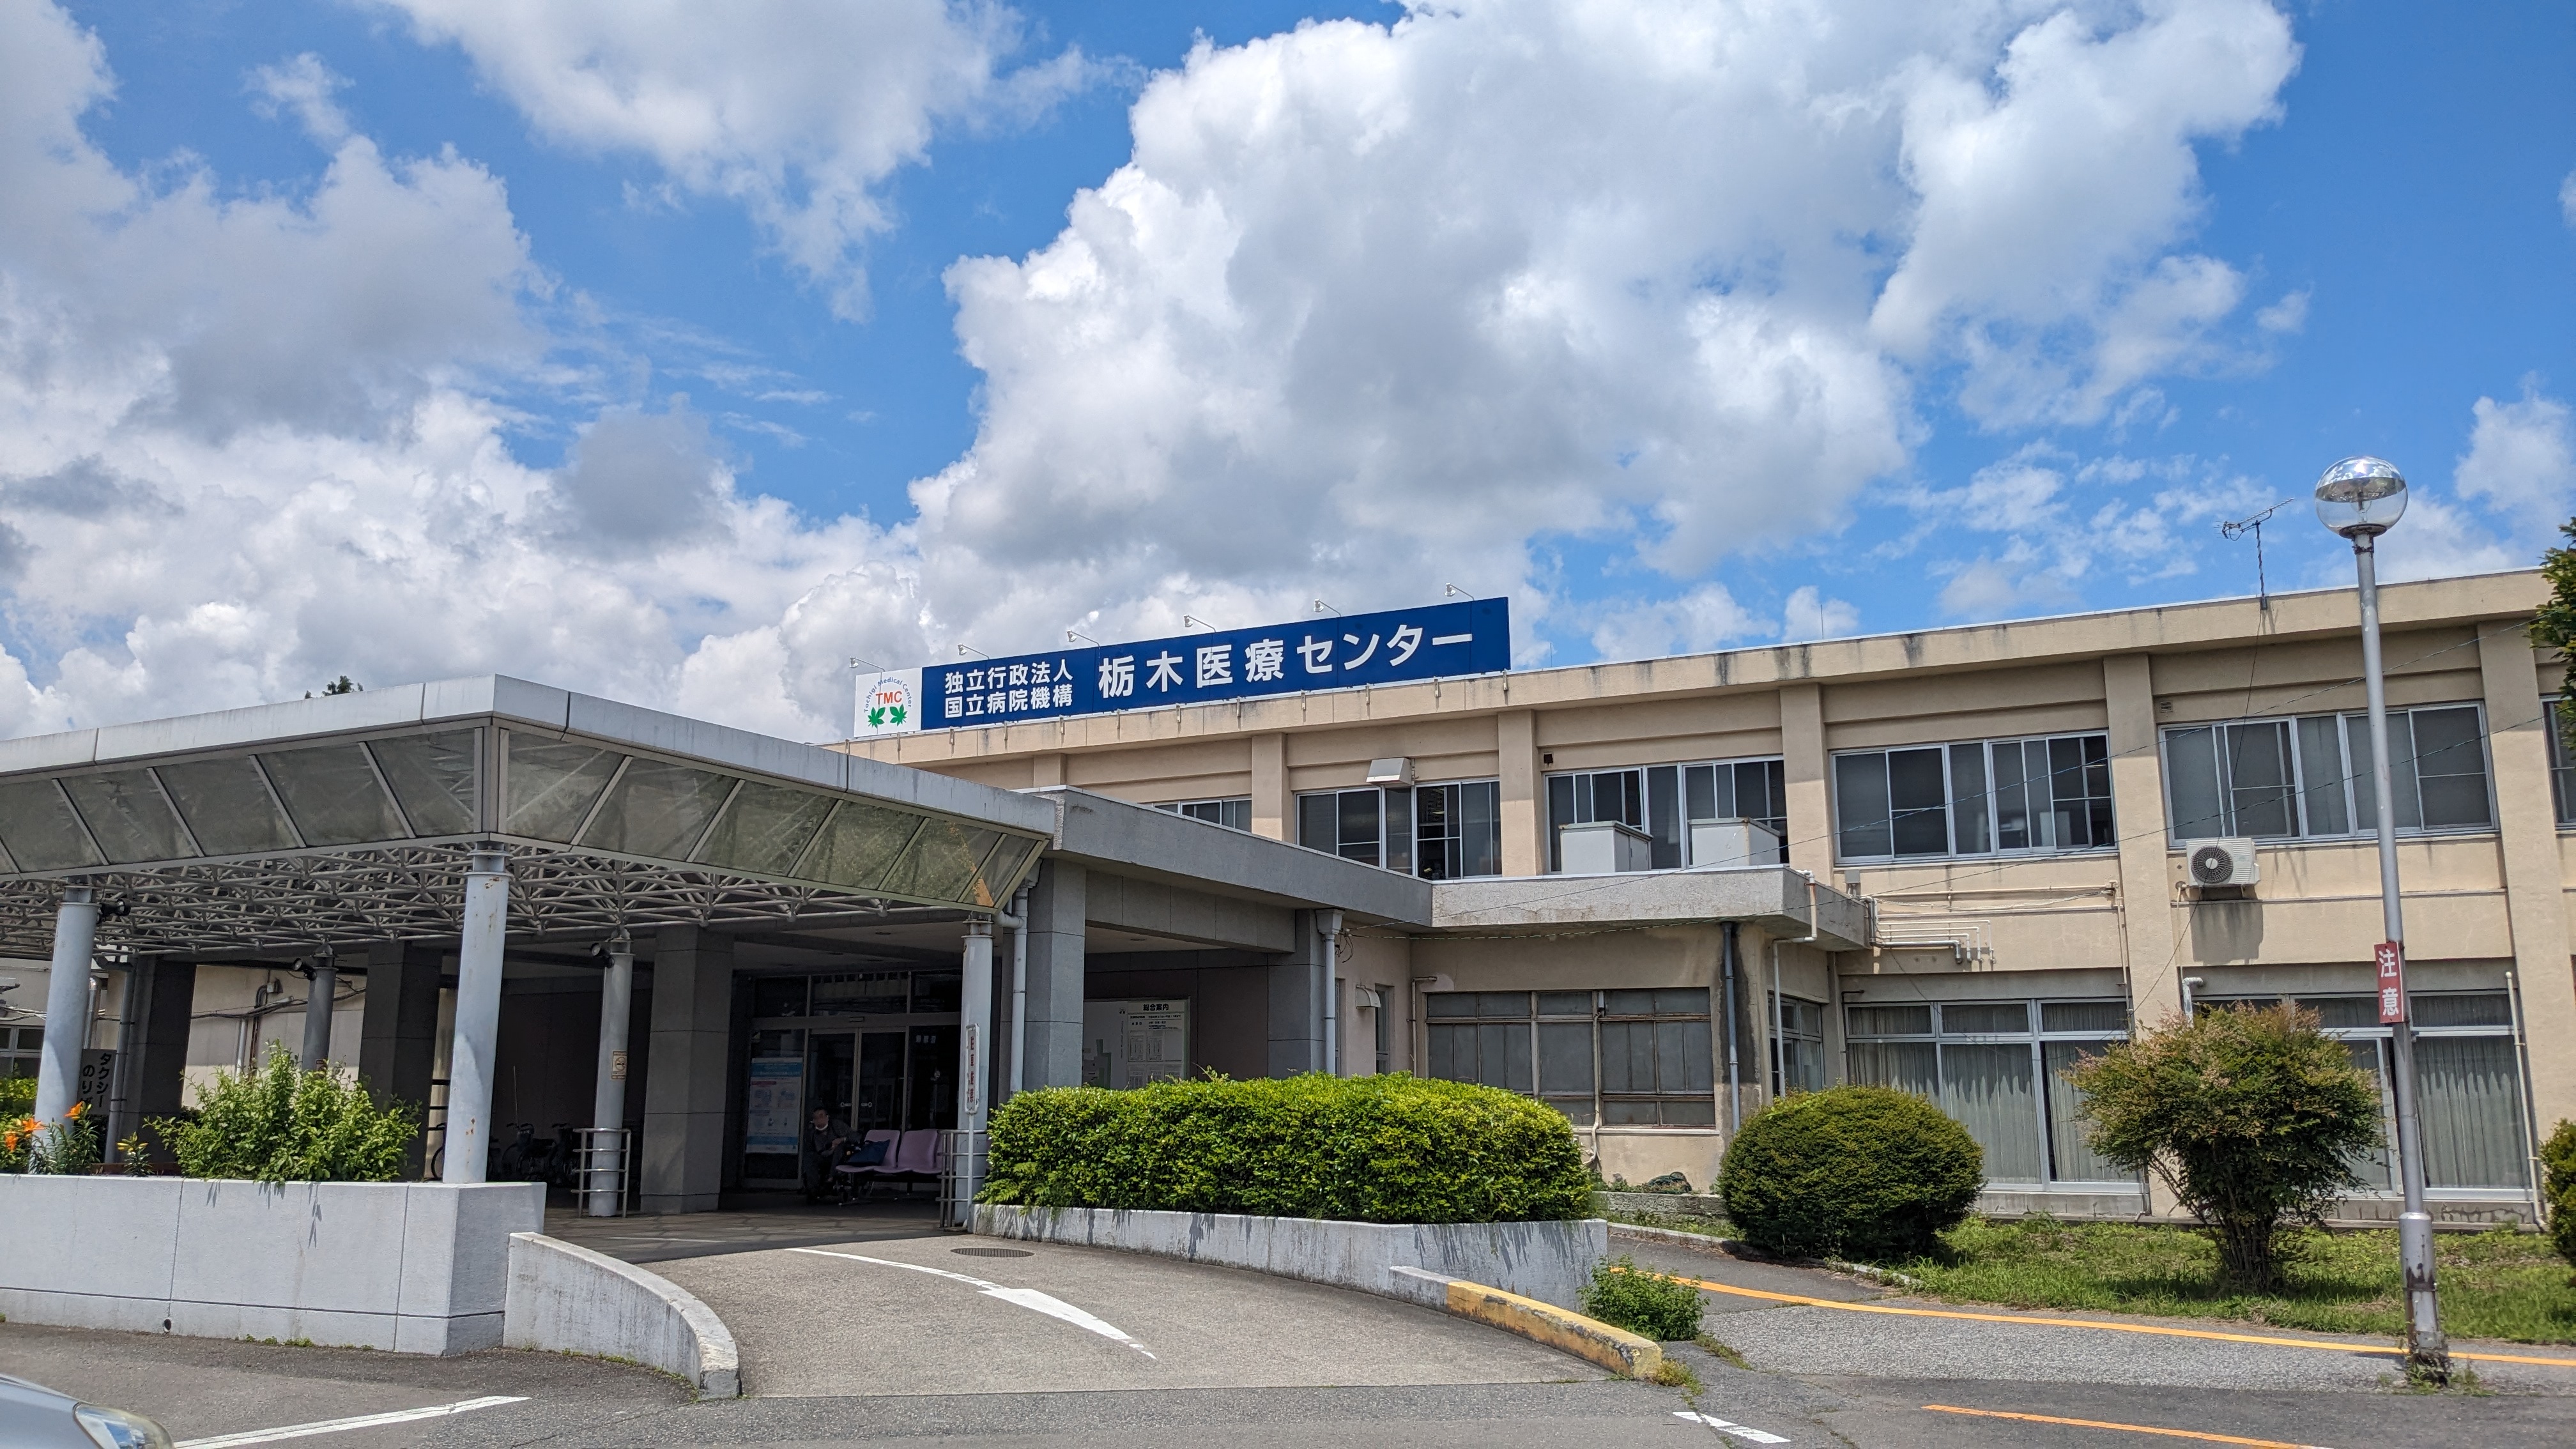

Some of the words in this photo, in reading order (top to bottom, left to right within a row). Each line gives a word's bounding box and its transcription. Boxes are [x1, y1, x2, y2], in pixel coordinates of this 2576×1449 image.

[944, 659, 1073, 694] 独立行政法人
[1098, 624, 1473, 699] 栃木医療センター
[864, 684, 878, 713] Tochigi
[877, 677, 903, 687] Medical
[902, 684, 912, 708] Center
[875, 691, 903, 705] TMC
[944, 684, 1073, 719] 国立病院機構
[2378, 948, 2399, 1016] 注意
[96, 1052, 112, 1108] タクシー
